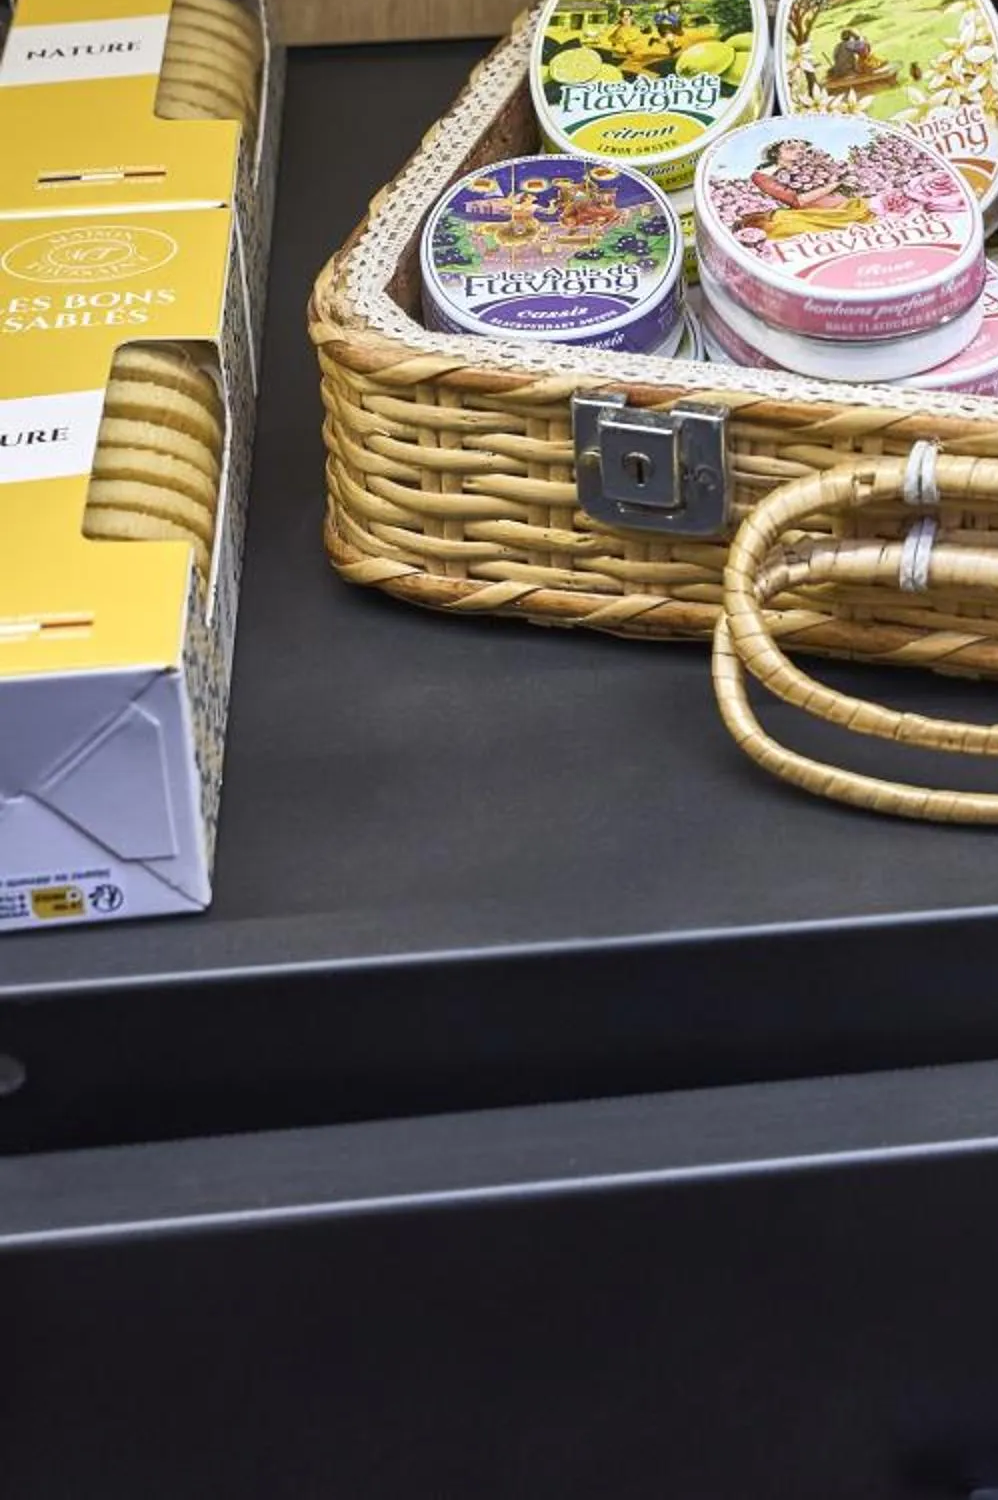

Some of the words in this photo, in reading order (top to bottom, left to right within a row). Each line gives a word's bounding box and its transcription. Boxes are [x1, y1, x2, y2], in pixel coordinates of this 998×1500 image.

[27, 41, 141, 60] NATURE
[633, 75, 686, 94] Anis
[691, 75, 719, 87] de
[561, 84, 720, 113] Flavigny
[955, 107, 983, 127] de
[602, 124, 676, 140] citron
[773, 219, 952, 264] Flavigny
[543, 266, 601, 282] Anis
[606, 263, 640, 276] de
[464, 273, 640, 298] Flavigny
[0, 295, 52, 315] ES
[64, 289, 178, 310] BONS
[803, 299, 874, 317] bonbons
[2, 304, 150, 334] SABLÉS
